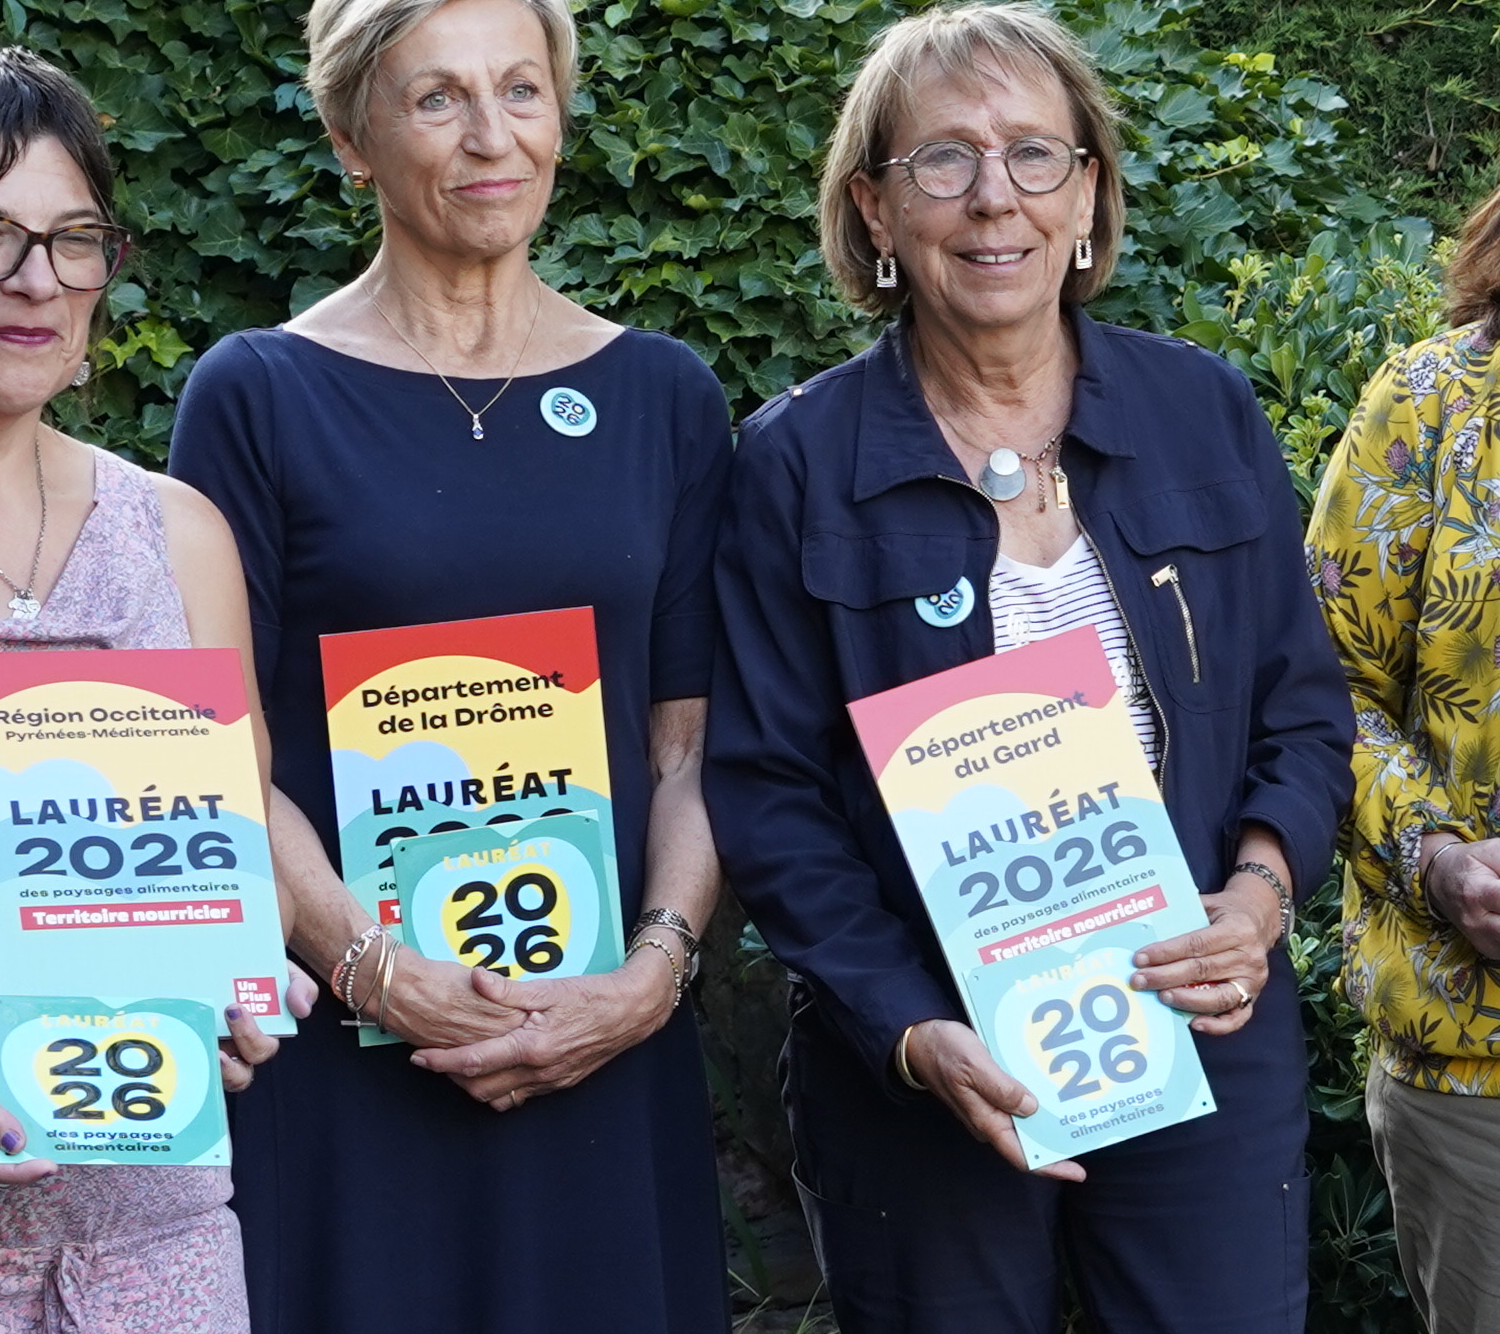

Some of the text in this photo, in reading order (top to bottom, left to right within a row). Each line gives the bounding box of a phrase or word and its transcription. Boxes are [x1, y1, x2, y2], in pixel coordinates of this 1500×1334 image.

[362, 670, 565, 709] Département
[90, 705, 216, 722] Occitanie
[378, 702, 554, 735] de la Drôme
[905, 690, 1089, 766] Département
[6, 726, 210, 742] Pyrénées-Méditerranée
[954, 727, 1062, 779] du Gard
[10, 784, 224, 826] LAURÉAT
[371, 762, 573, 816] LAURÉAT
[940, 782, 1122, 867] LAURÉAT
[14, 831, 237, 880] 2026
[443, 839, 551, 871] LAURÉAT
[958, 820, 1148, 918] 2026
[19, 881, 239, 898] des paysages alimentaires
[379, 882, 397, 891] de
[451, 873, 557, 931] 20
[974, 868, 1156, 939] des paysages alimentaires
[32, 905, 230, 926] Territoire nourricier
[990, 895, 1155, 962] Territoire nourricier
[459, 925, 564, 977] 26
[237, 981, 258, 991] Un
[239, 992, 271, 1002] Plus
[41, 1011, 161, 1029] LAURÉAT
[1031, 983, 1130, 1051] 20
[46, 1038, 164, 1078] 20
[1049, 1034, 1148, 1103] 26
[49, 1082, 166, 1121] 26
[1059, 1086, 1163, 1127] des paysages
[1070, 1102, 1164, 1139] alimentaires
[46, 1129, 174, 1141] des paysages
[54, 1141, 171, 1152] alimentaires
